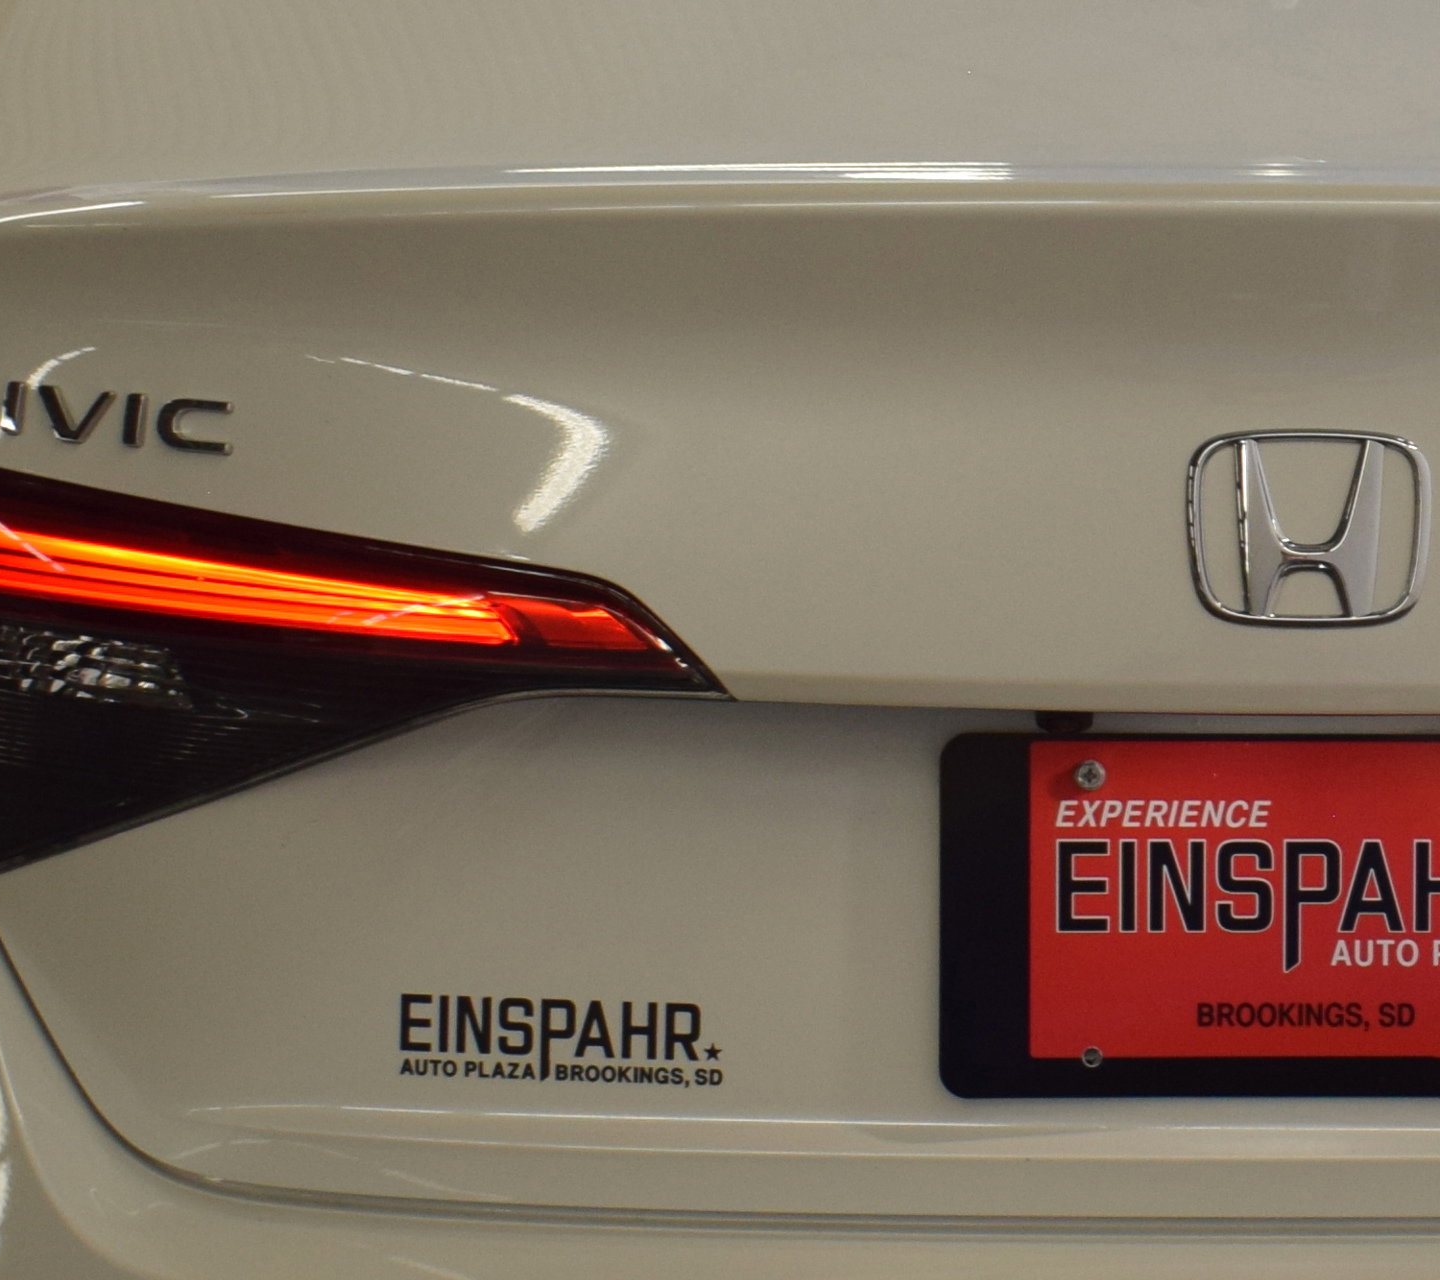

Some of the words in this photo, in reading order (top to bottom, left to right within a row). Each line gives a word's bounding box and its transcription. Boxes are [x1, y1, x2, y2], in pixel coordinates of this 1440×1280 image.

[1055, 800, 1272, 829] EXPERIENCE
[1330, 939, 1420, 968] AUTO
[1196, 1002, 1372, 1031] BROOKINGS,
[1378, 1002, 1416, 1028] SD
[399, 992, 702, 1082] EINSPAHR
[400, 1057, 458, 1078] AUTO
[464, 1060, 536, 1081] PLAZA
[554, 1063, 691, 1089] BROOKINGS,
[694, 1067, 724, 1087] SD
